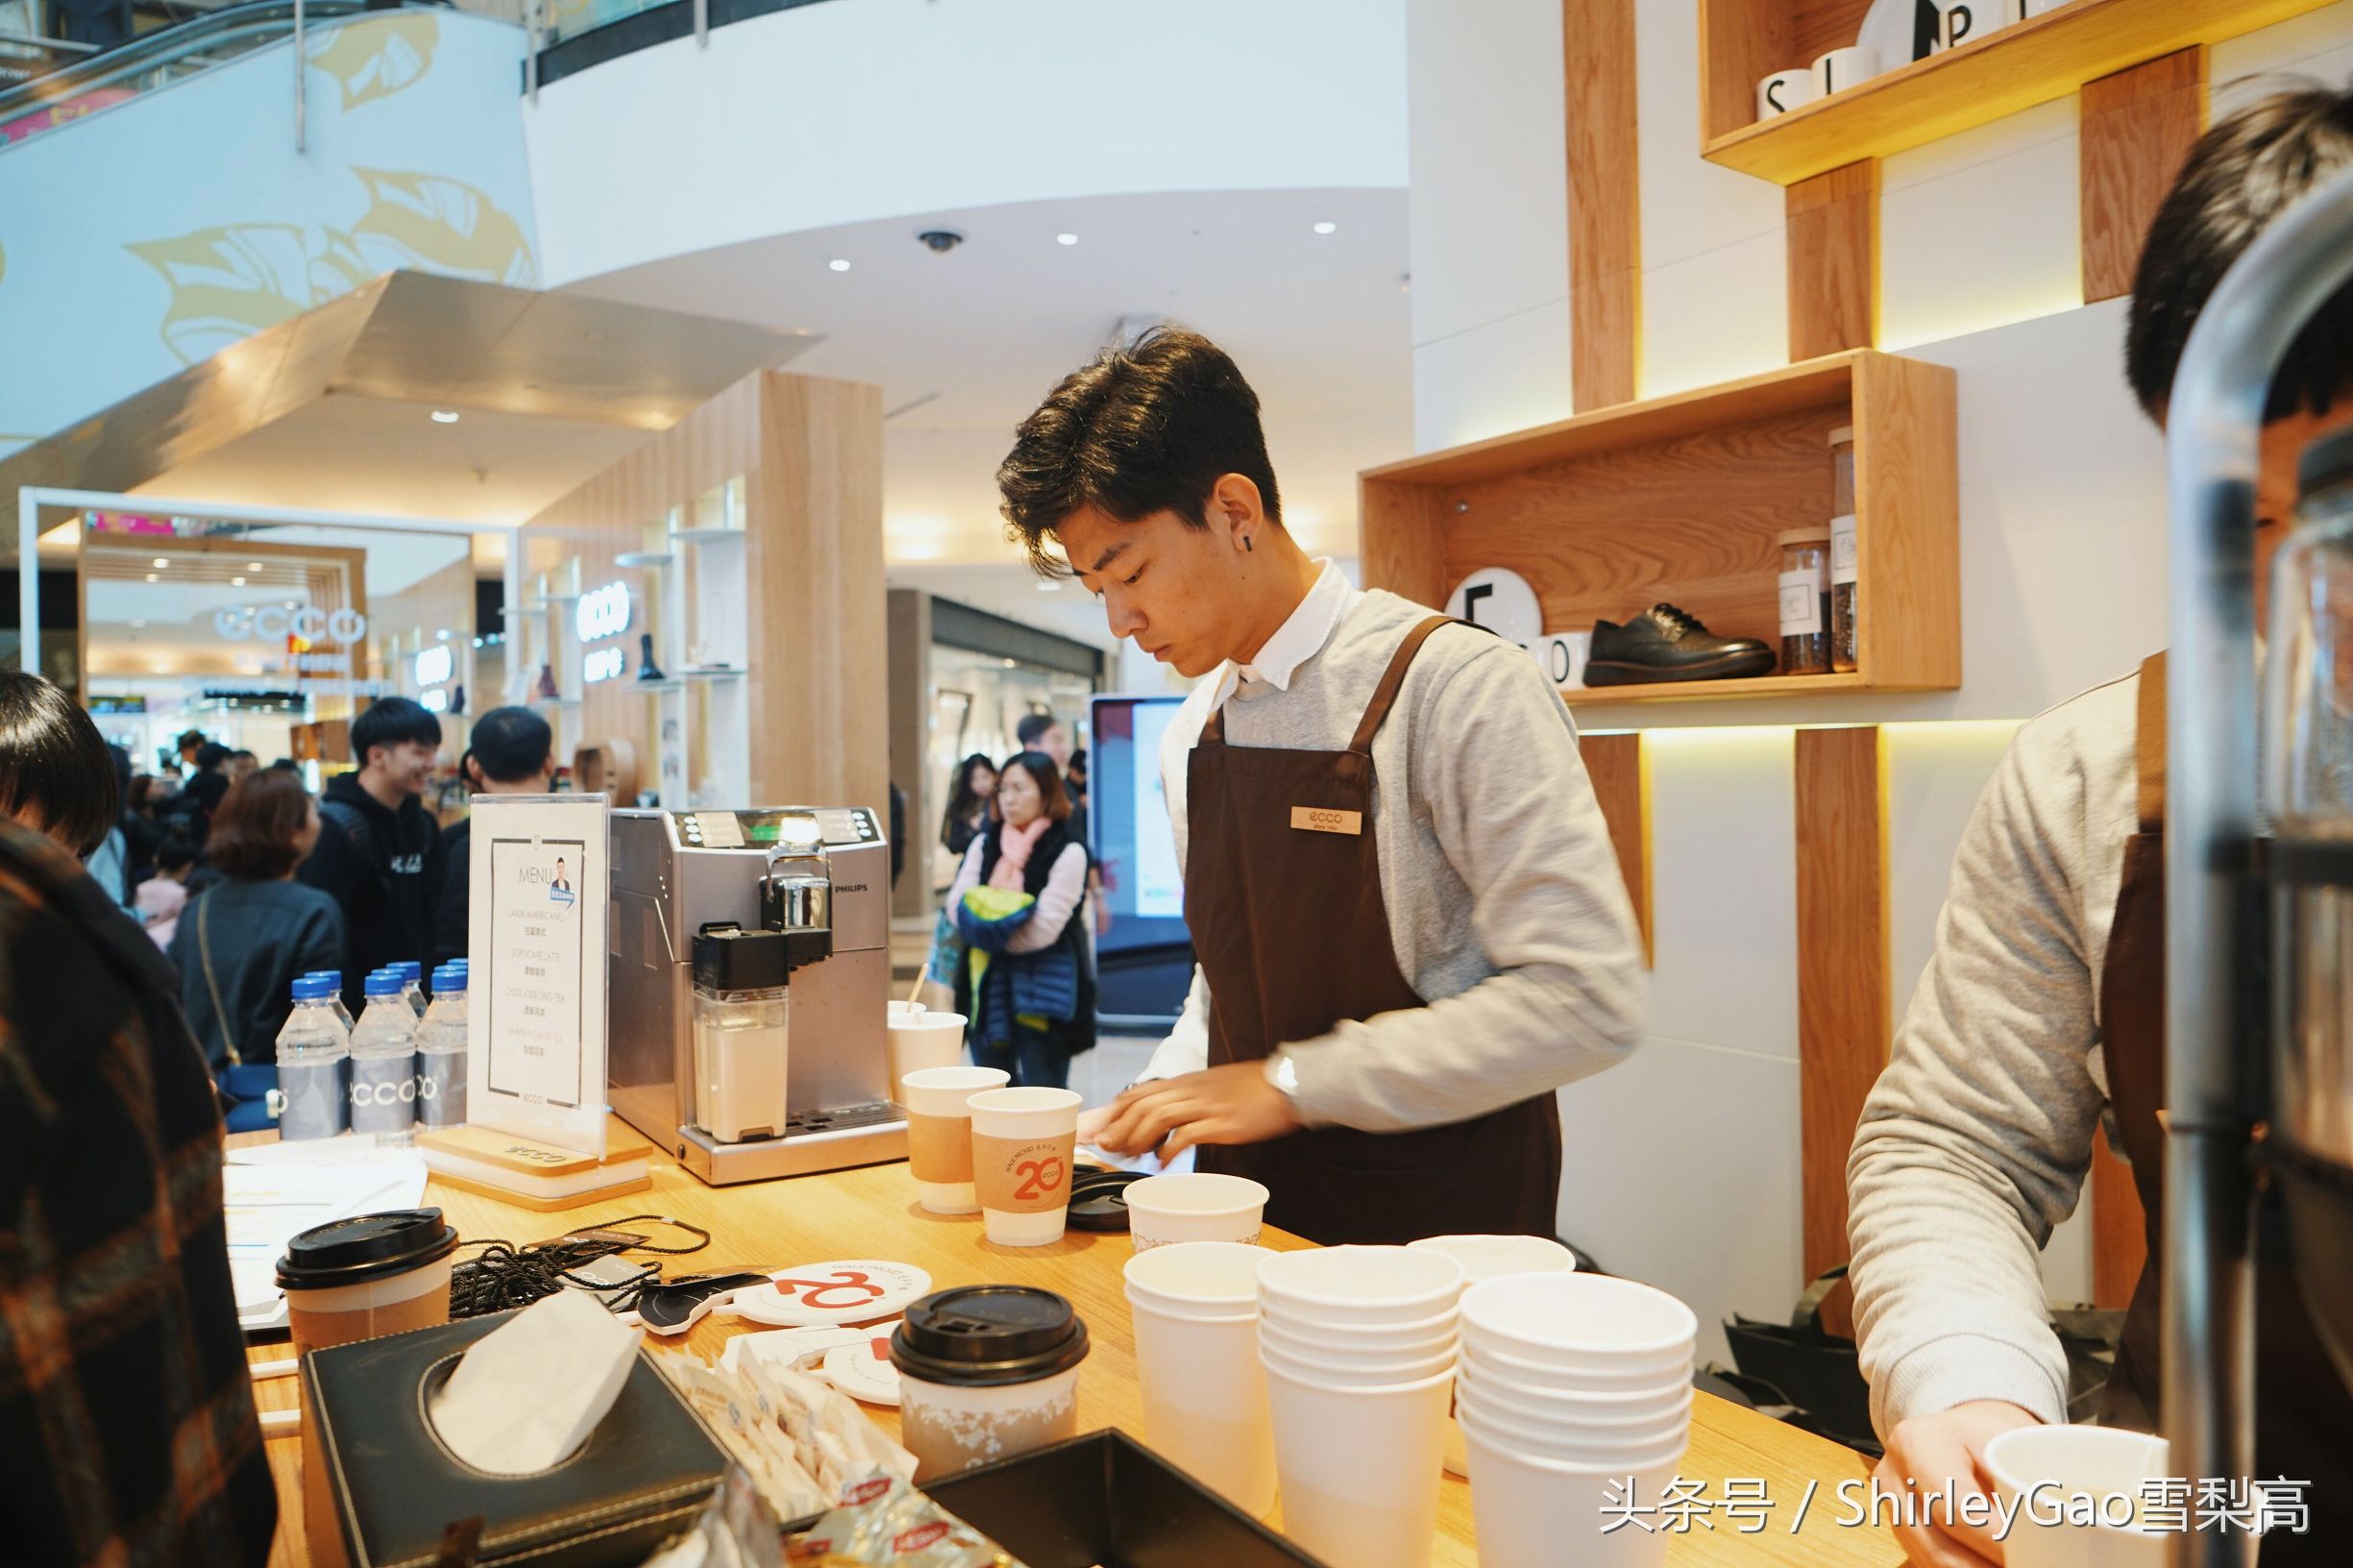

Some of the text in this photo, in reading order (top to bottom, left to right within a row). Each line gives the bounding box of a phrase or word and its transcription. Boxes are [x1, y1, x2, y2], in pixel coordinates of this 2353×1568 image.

[1310, 811, 1343, 824] ecco
[519, 867, 552, 885] MENU
[835, 883, 869, 893] PHILIPS
